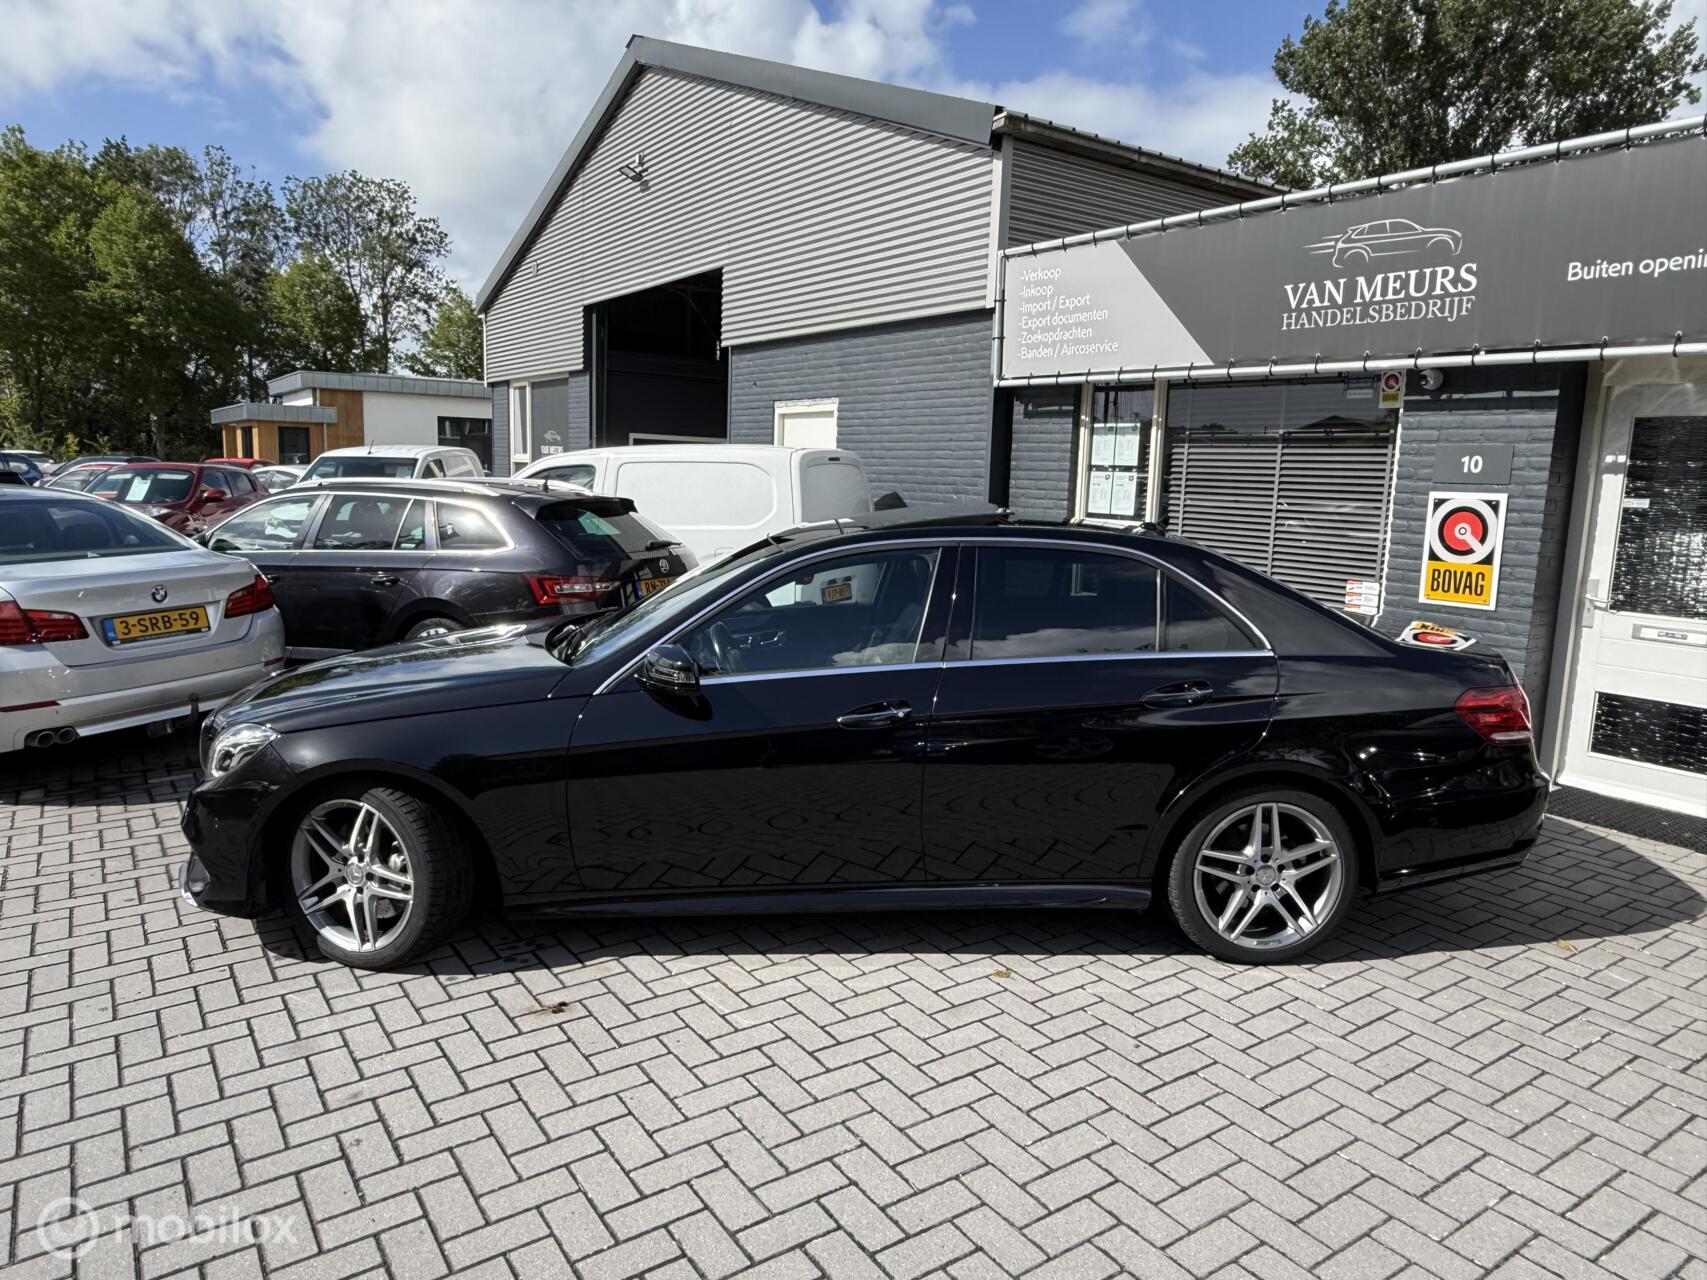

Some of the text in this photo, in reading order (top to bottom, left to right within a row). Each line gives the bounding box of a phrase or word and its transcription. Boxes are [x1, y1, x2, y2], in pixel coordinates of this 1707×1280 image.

[1020, 267, 1062, 281] -Verkoop
[1567, 259, 1634, 281] Buiten
[1019, 284, 1054, 298] -Inkoop
[1284, 262, 1478, 309] VAN MEURS
[1019, 300, 1051, 315] -Import
[1059, 293, 1091, 311] Export
[1281, 295, 1476, 331] HANDELSBEDRIJF
[1018, 309, 1108, 331] -Export documenten
[1018, 326, 1093, 344] -Zoekopdrachten
[1018, 344, 1053, 359] -Banden
[1061, 339, 1119, 356] Aircoservice
[1461, 455, 1483, 473] 10
[1430, 568, 1486, 597] BOVAG
[119, 611, 200, 636] 3-SRB-59
